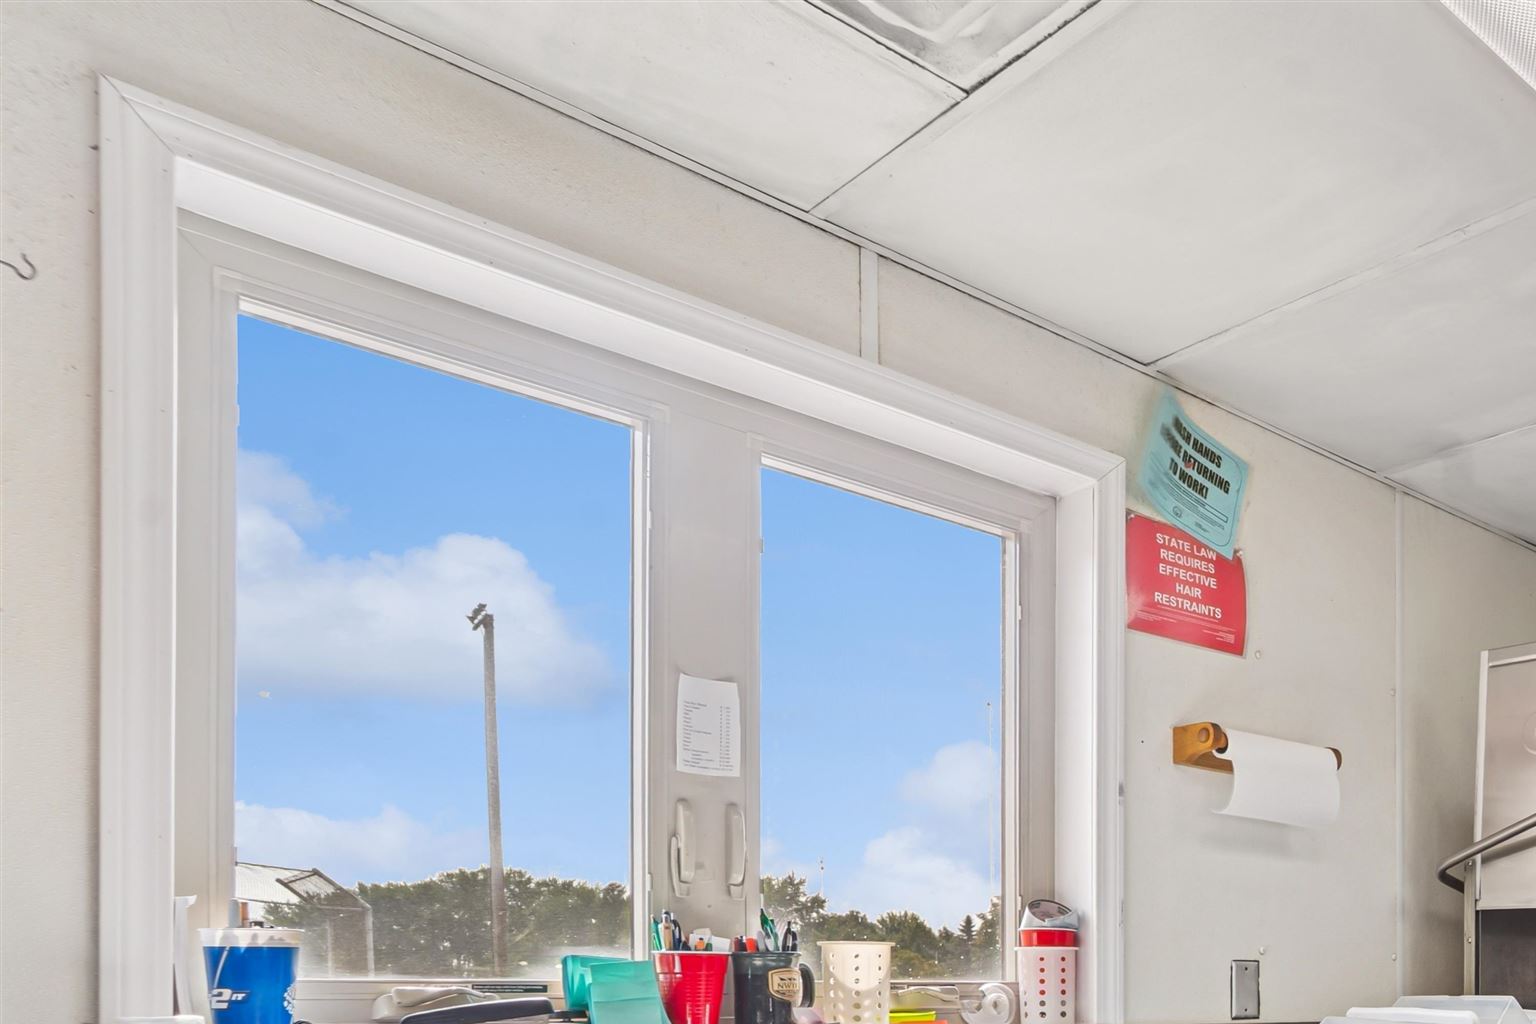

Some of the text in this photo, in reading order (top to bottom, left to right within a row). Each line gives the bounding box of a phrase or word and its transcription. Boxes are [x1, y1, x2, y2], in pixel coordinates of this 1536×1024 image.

[1173, 415, 1222, 468] ASH HANDS
[1169, 457, 1178, 476] TO
[1178, 470, 1209, 500] WORK!
[1182, 450, 1231, 495] RETURNING
[1156, 533, 1217, 561] STATE LAW
[1160, 549, 1215, 574] REQUIRES
[1159, 563, 1217, 589] EFFECTIVE
[1175, 583, 1202, 599] HAIR
[1154, 592, 1222, 619] RESTRAINTS
